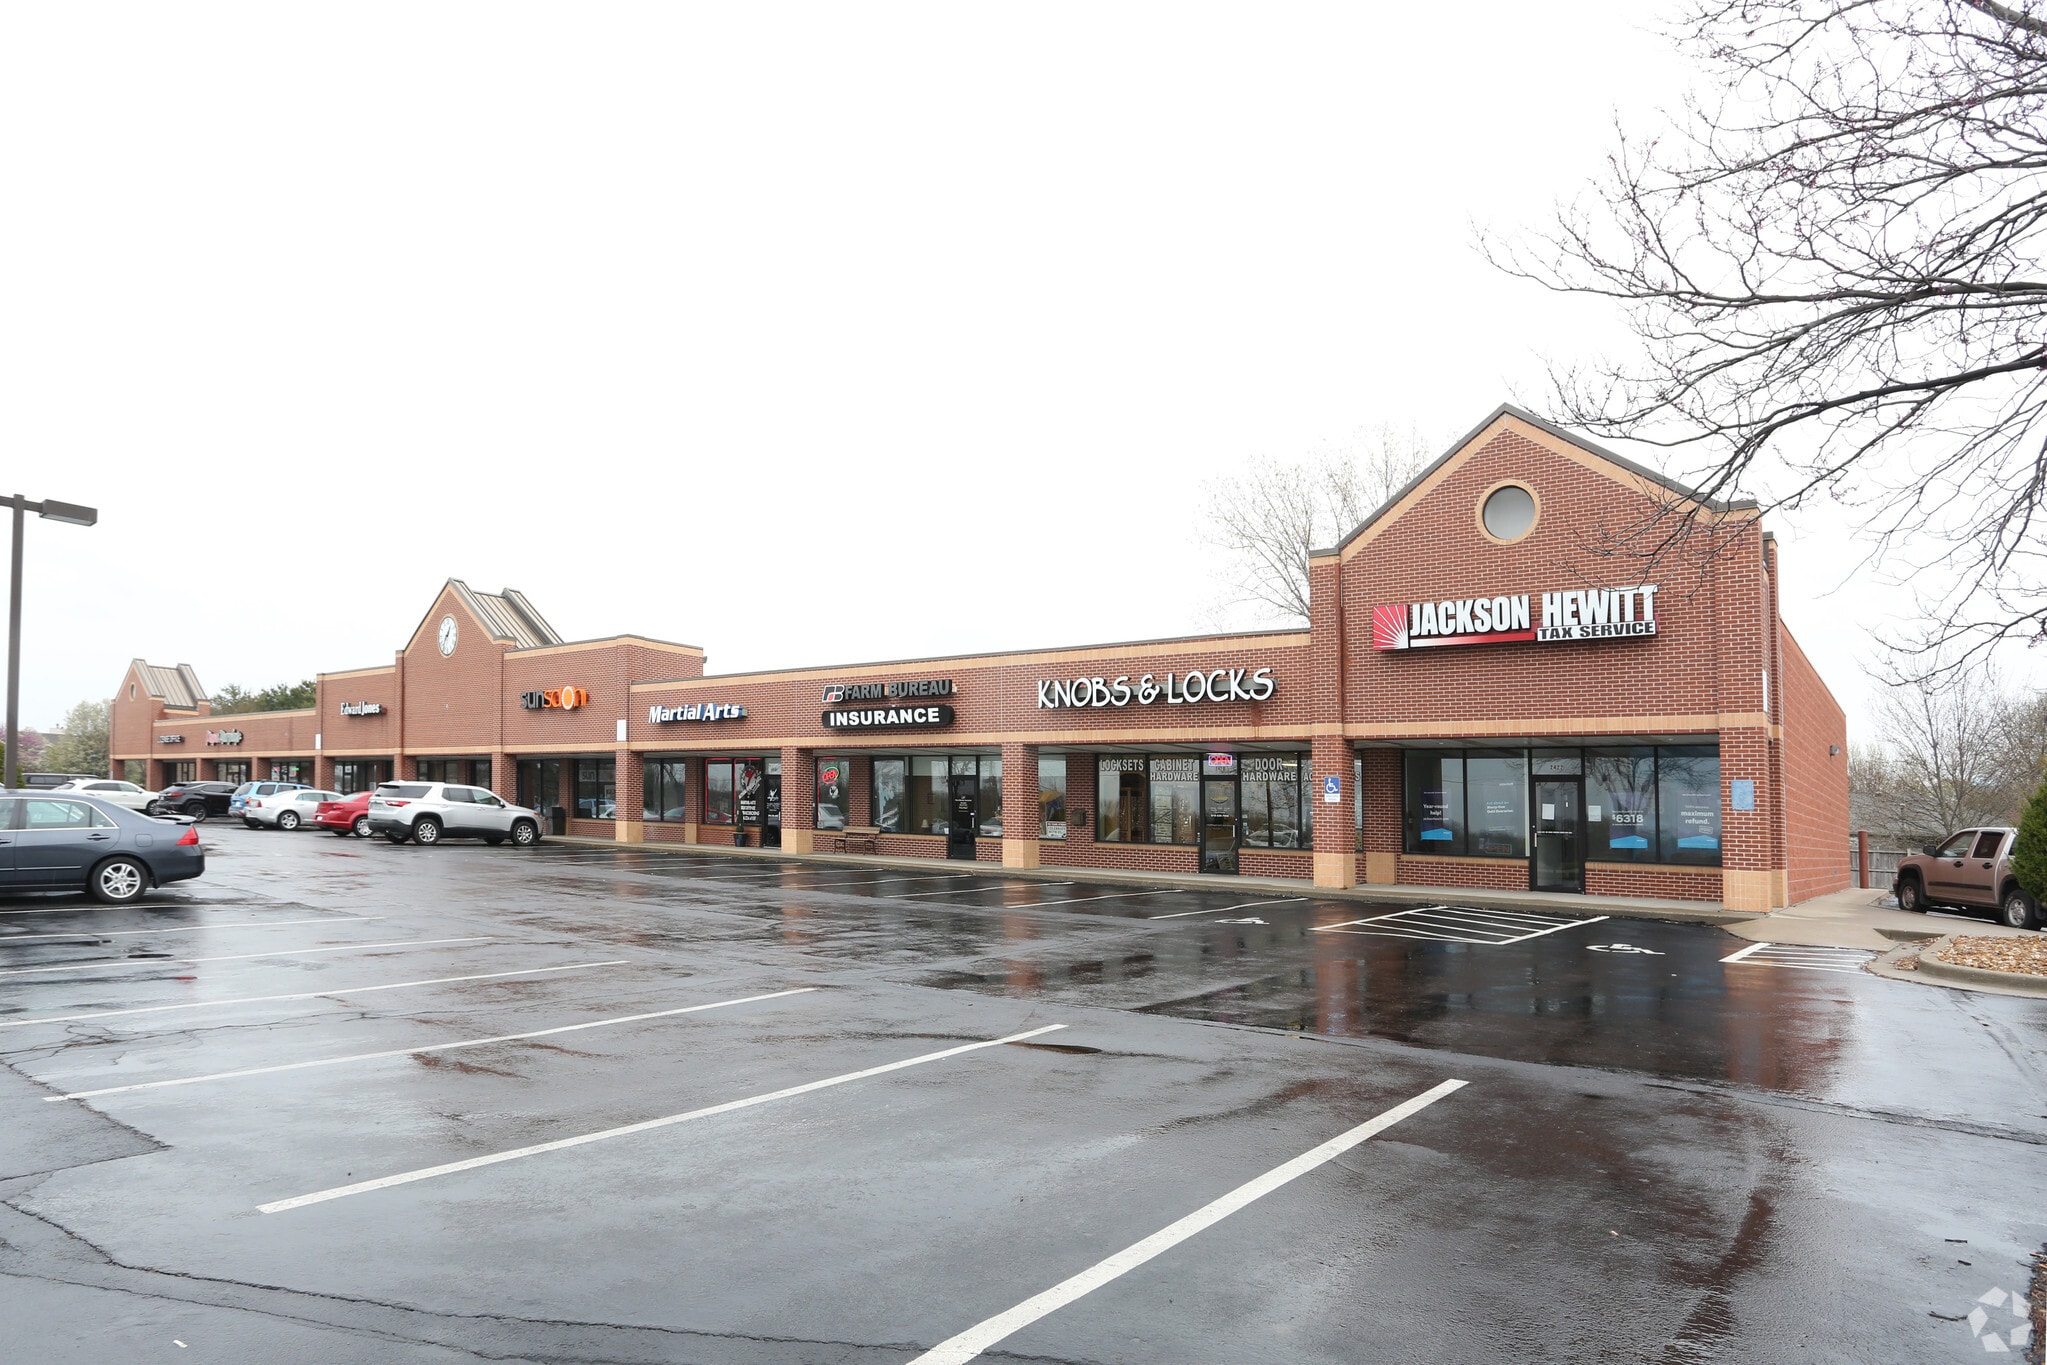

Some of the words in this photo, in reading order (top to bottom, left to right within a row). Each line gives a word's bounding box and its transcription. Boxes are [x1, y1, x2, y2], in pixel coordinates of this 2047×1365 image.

[1410, 595, 1530, 636] JACKSON
[1542, 585, 1658, 627] HEWITT
[1539, 627, 1574, 640] TAX
[1579, 622, 1655, 637] SERVICE
[845, 684, 882, 700] FARM
[889, 680, 951, 697] BUREAU
[1038, 676, 1131, 709] KNOBS
[1138, 673, 1160, 705] &
[1168, 668, 1275, 704] LOCKS
[648, 704, 702, 723] Martial
[702, 703, 740, 721] Arts
[830, 708, 940, 726] INSURANCE
[1100, 759, 1144, 771] LOCKSETS
[1154, 759, 1194, 772] CABINET
[1210, 755, 1231, 765] OPEN
[1255, 758, 1283, 770] DOOR
[1150, 772, 1198, 781] HARDWARE
[1243, 772, 1296, 781] HARDWARE
[1612, 814, 1644, 823] $6318
